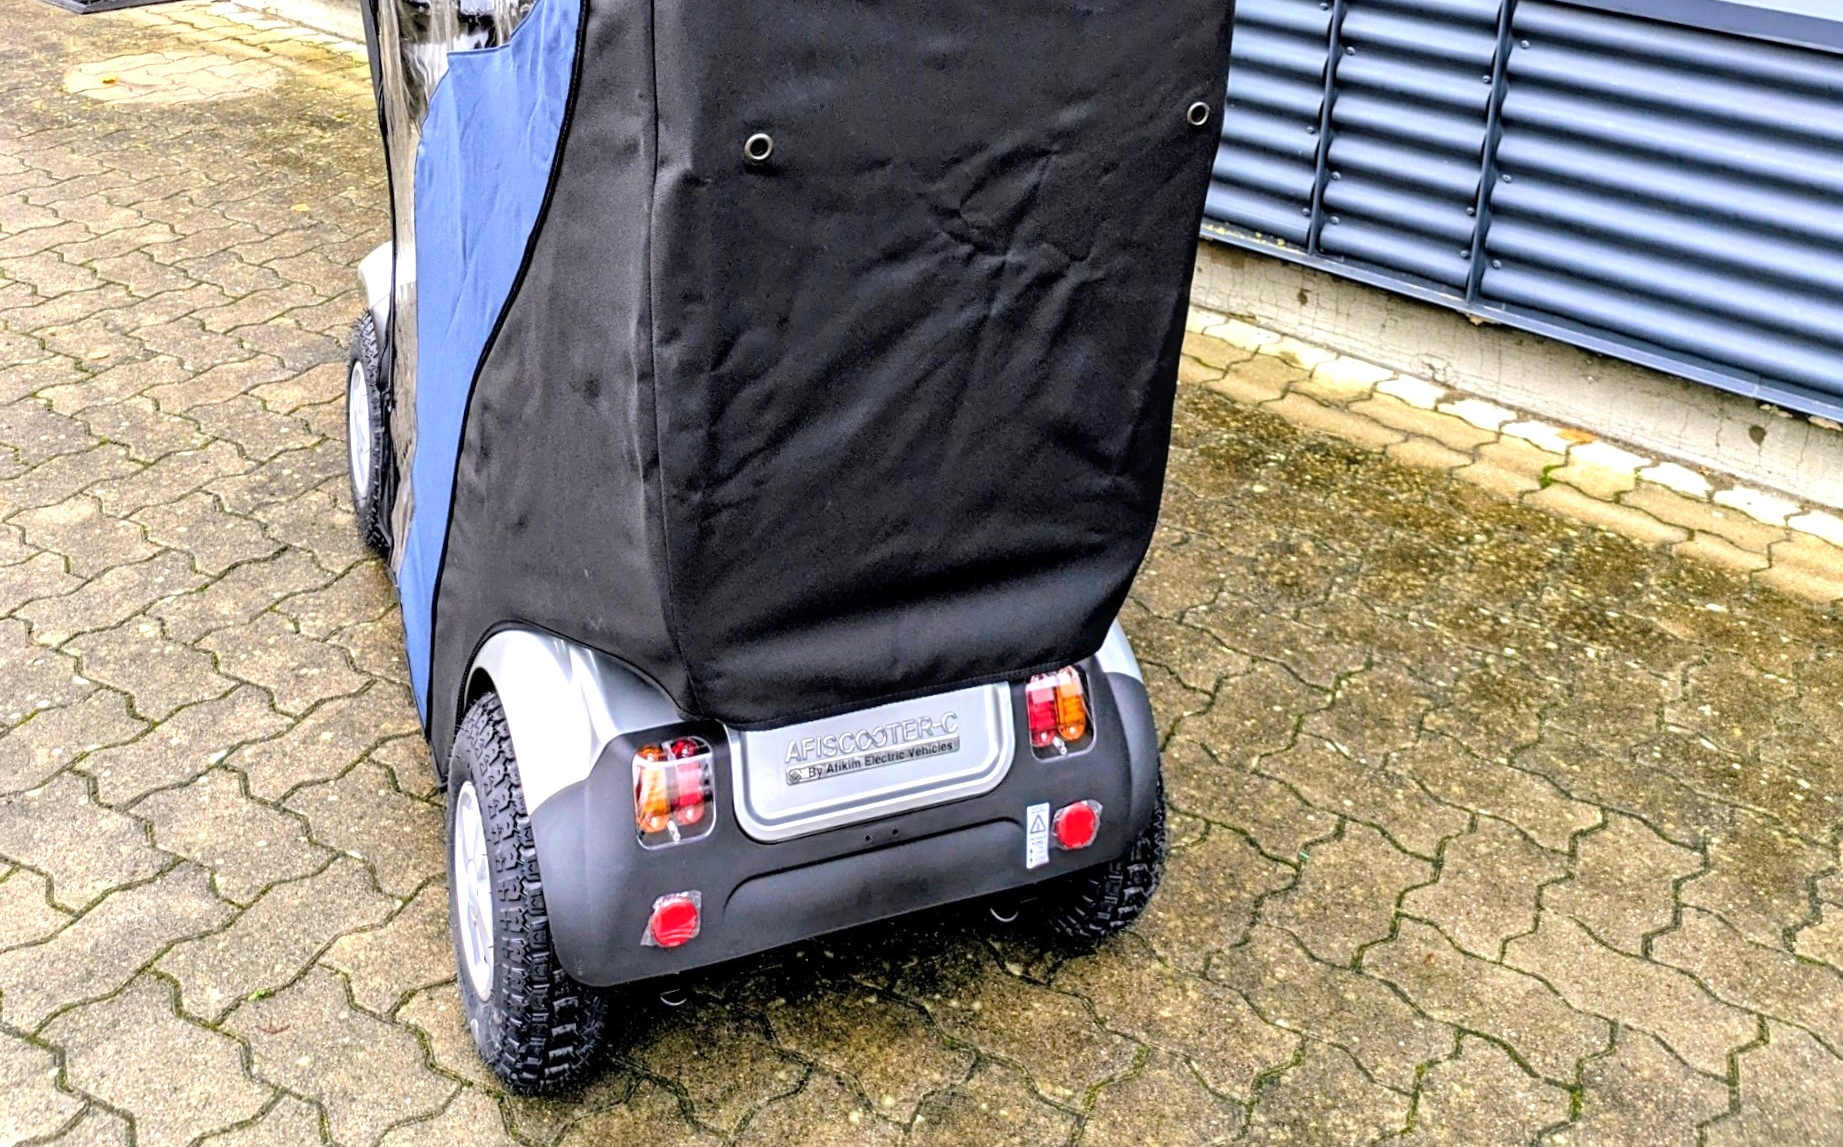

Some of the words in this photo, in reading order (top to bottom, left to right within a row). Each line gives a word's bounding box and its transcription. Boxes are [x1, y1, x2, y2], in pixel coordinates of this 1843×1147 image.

[785, 712, 958, 763] AFISCOOTER-C
[808, 766, 823, 779] By
[826, 759, 862, 775] Afikim
[864, 752, 905, 767] Electric
[908, 742, 953, 758] Vehicles
